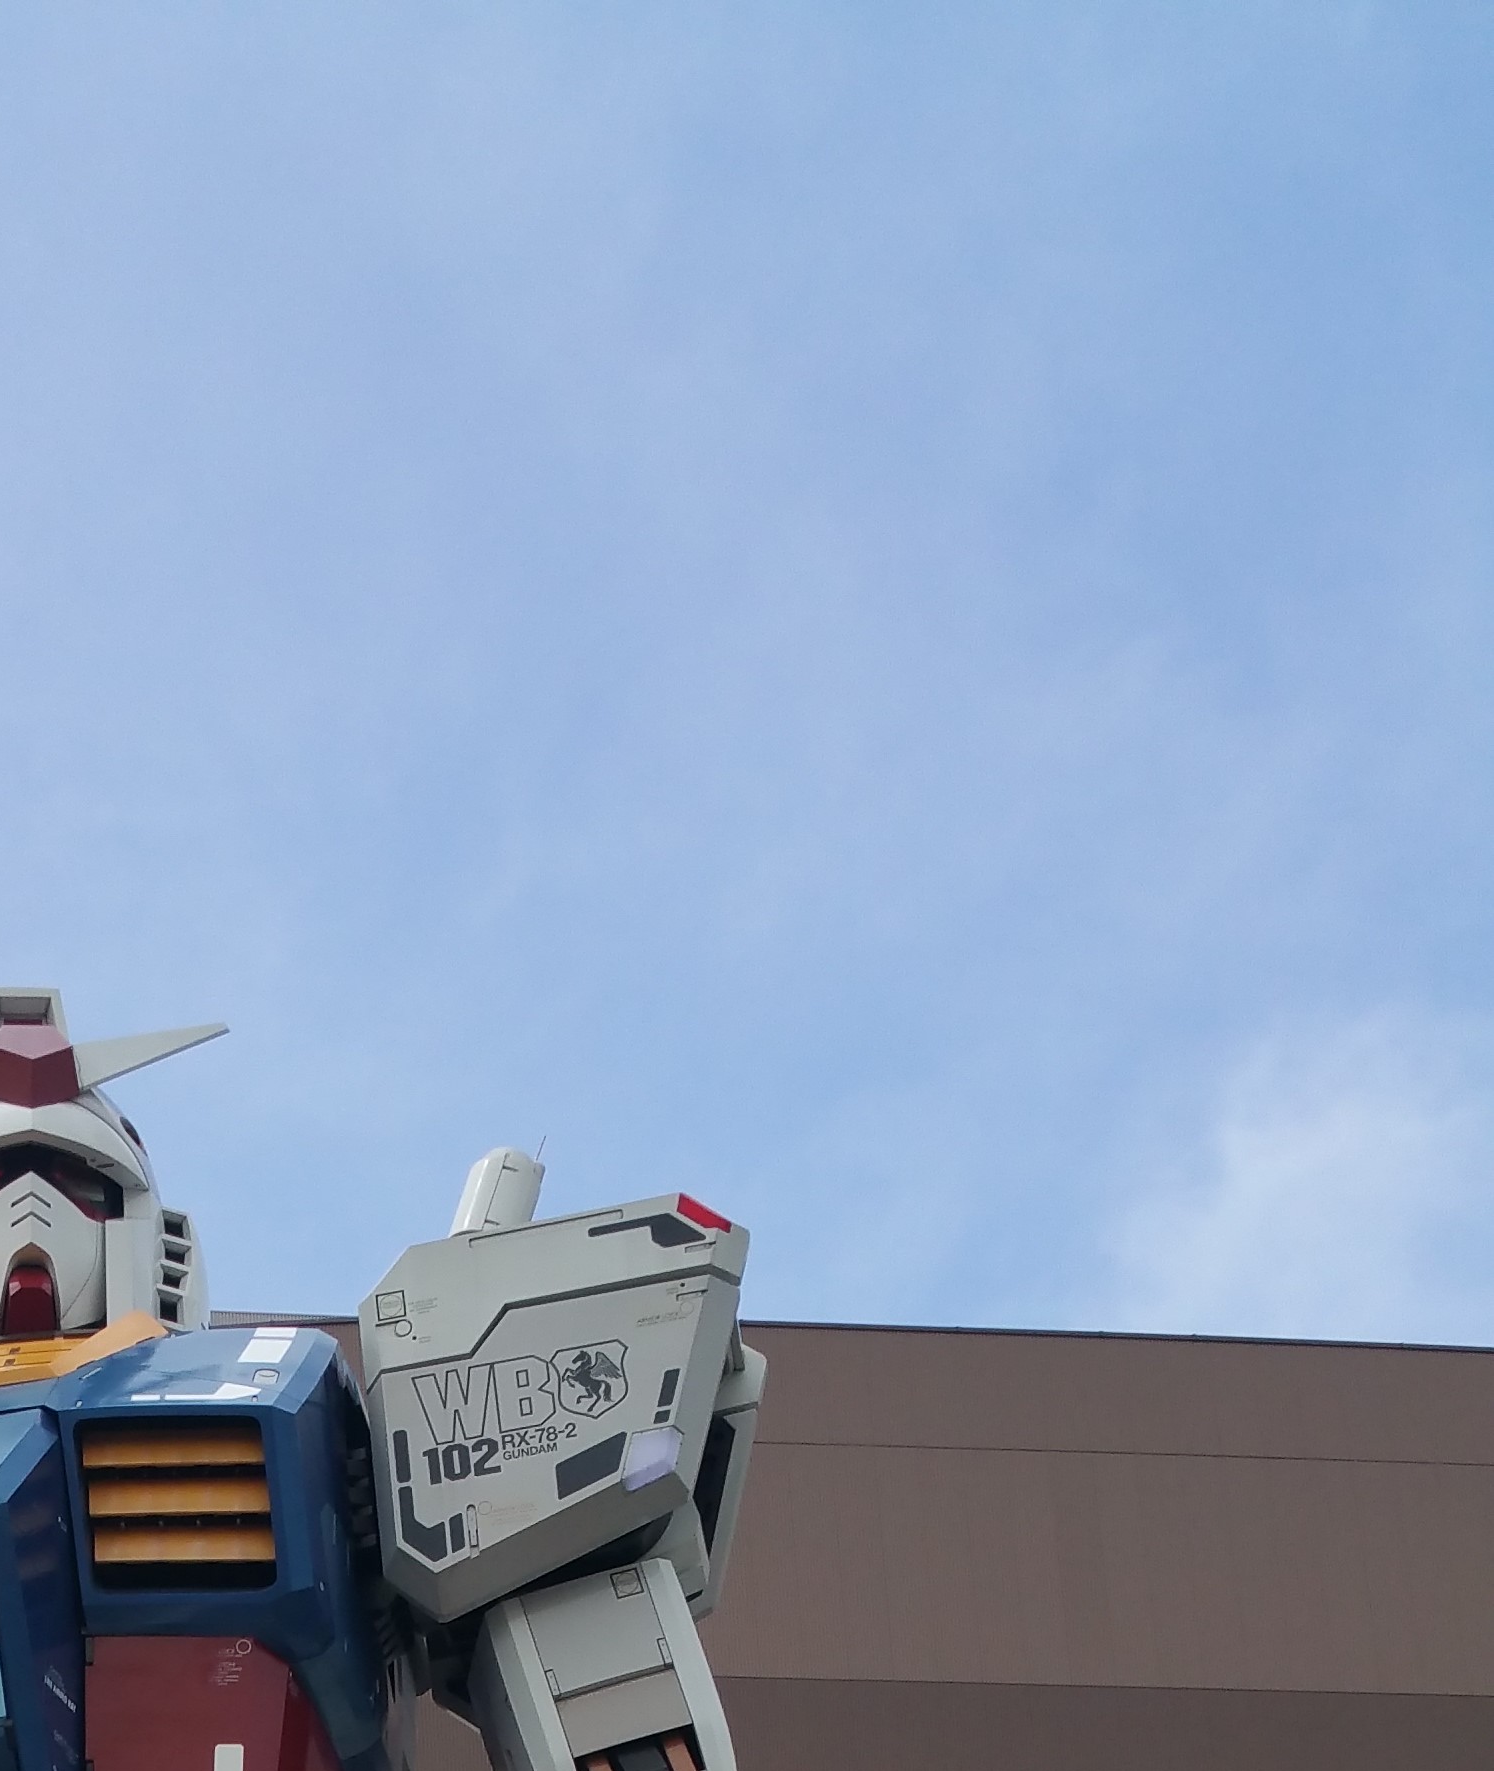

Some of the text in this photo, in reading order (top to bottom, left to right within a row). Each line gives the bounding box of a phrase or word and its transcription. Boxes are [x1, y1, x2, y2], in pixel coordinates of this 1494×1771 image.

[411, 1354, 556, 1445] WB
[501, 1422, 578, 1450] RX-78-2
[502, 1442, 558, 1461] GUNDAM
[422, 1438, 502, 1485] 102
